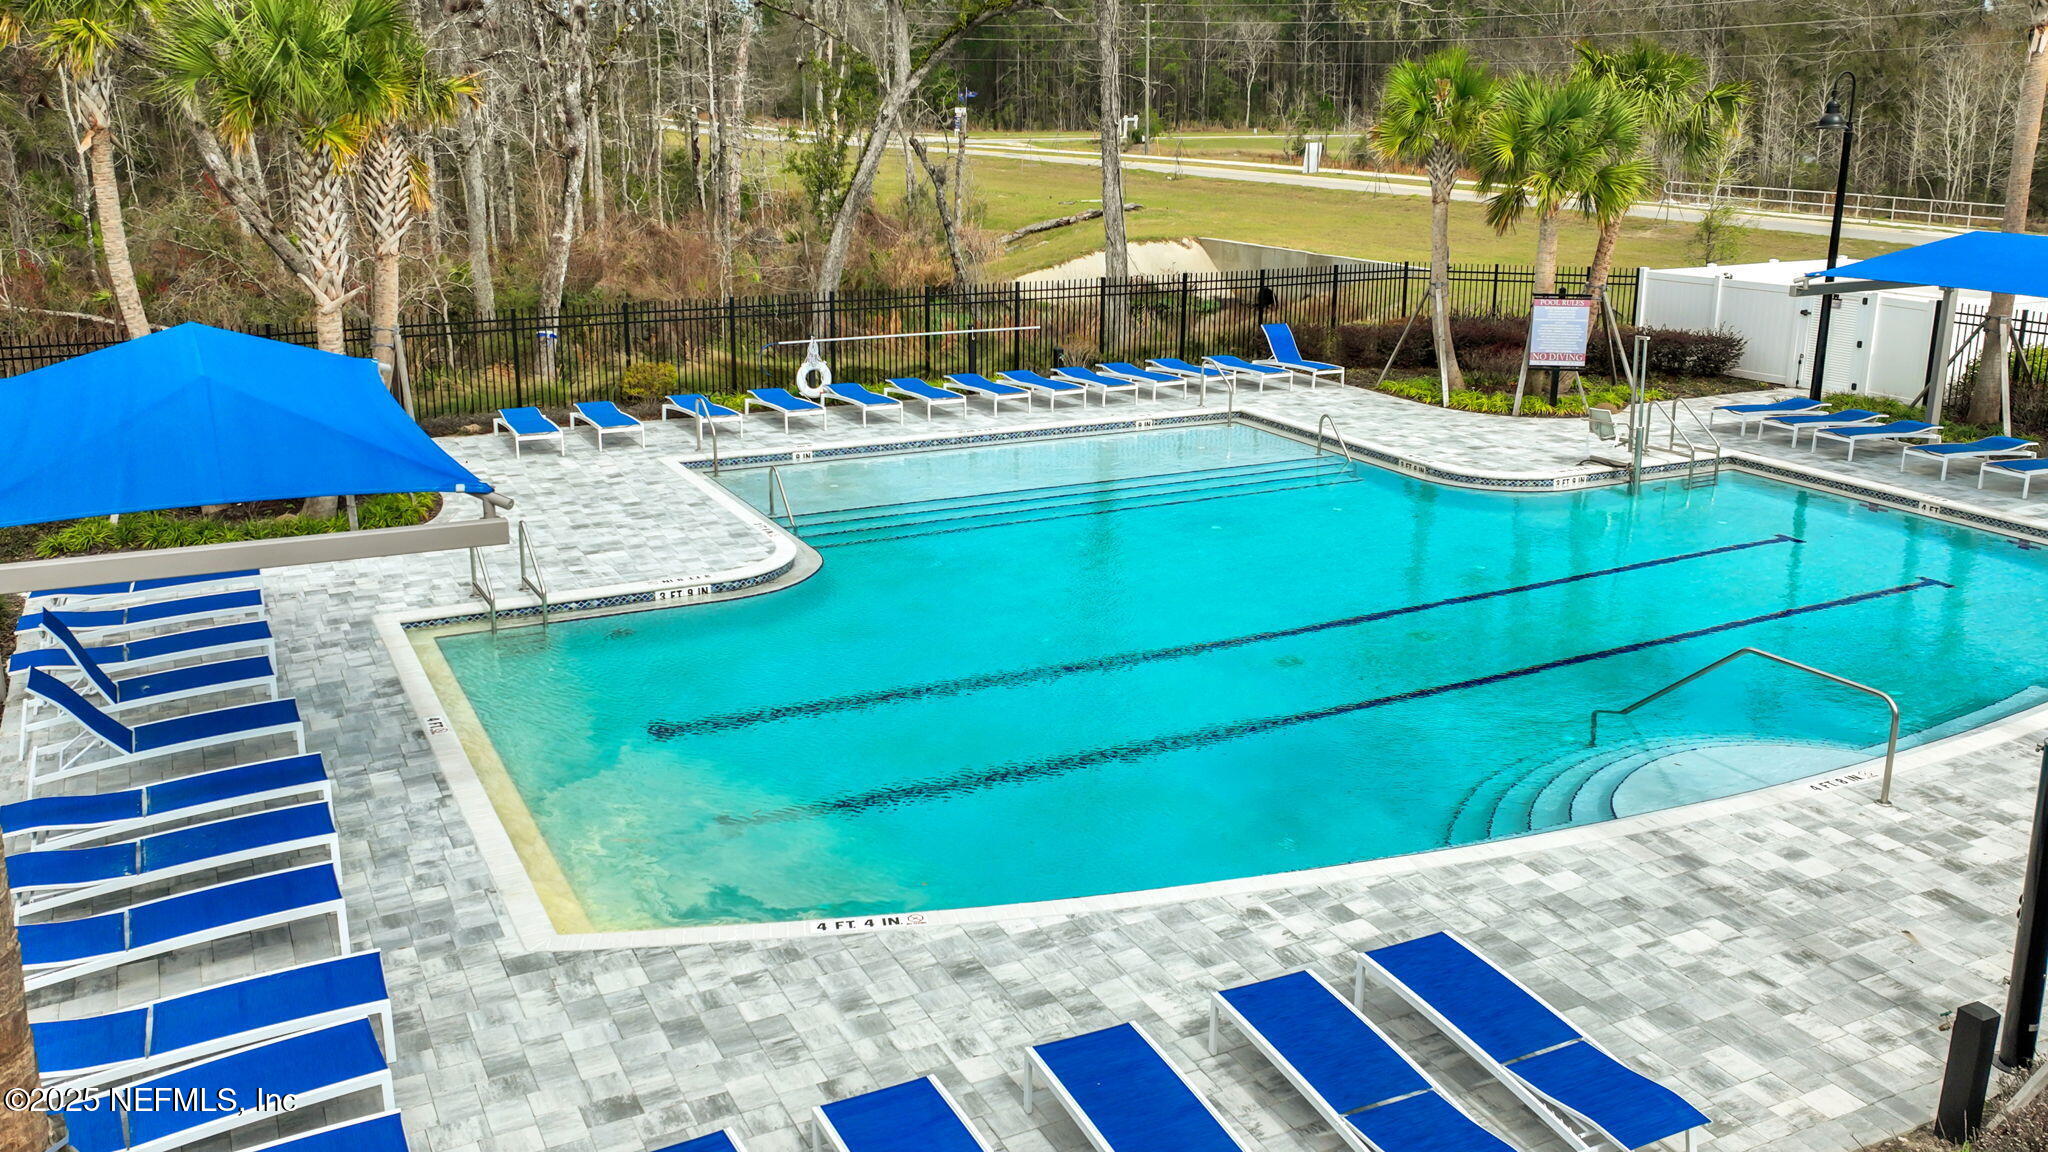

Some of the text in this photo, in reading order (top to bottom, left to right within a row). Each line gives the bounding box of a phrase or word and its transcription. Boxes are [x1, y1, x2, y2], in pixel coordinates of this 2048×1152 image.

[1532, 353, 1583, 361] NO DIVING
[659, 587, 709, 600] 3 FT 9 IN
[817, 922, 827, 931] 4
[835, 920, 856, 929] FT.
[864, 919, 875, 927] 4
[882, 916, 904, 926] IN.
